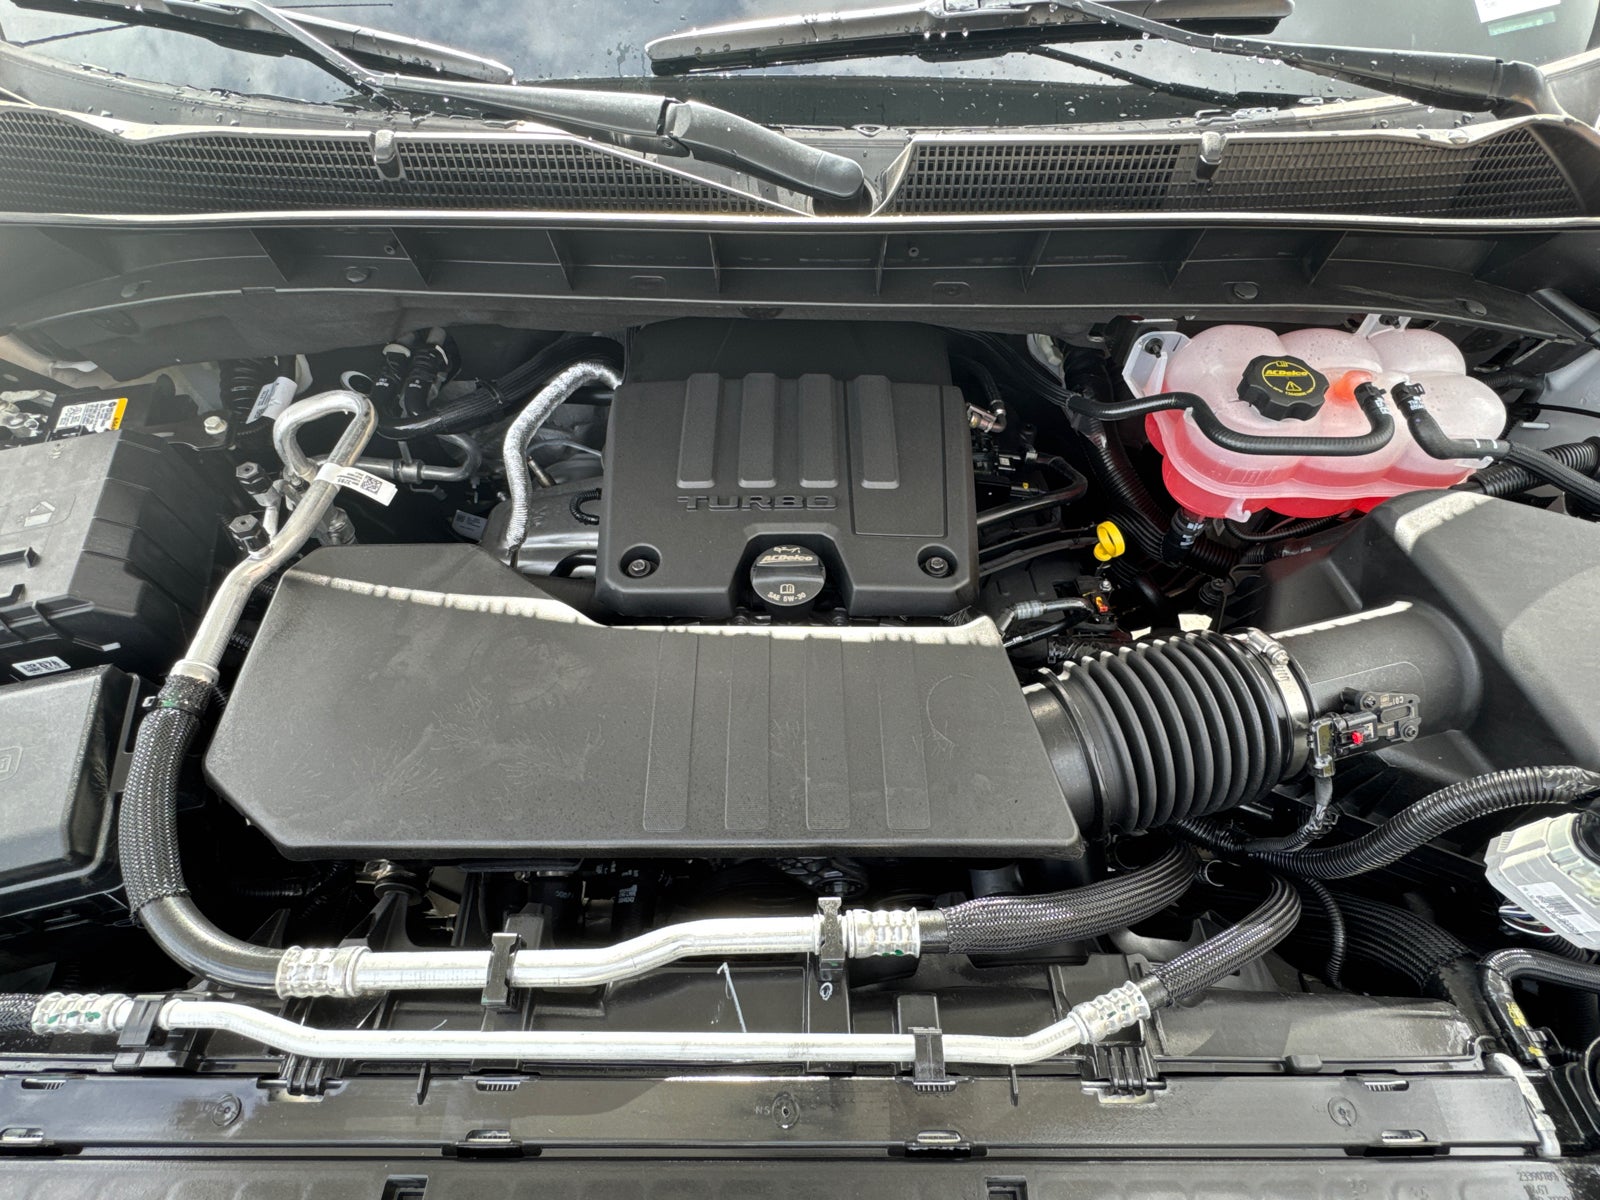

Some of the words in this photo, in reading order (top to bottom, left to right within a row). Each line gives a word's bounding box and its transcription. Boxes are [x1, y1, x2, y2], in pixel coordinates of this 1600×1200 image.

[677, 495, 837, 511] TURBO
[760, 554, 813, 563] ACDelco
[768, 591, 780, 600] SAE
